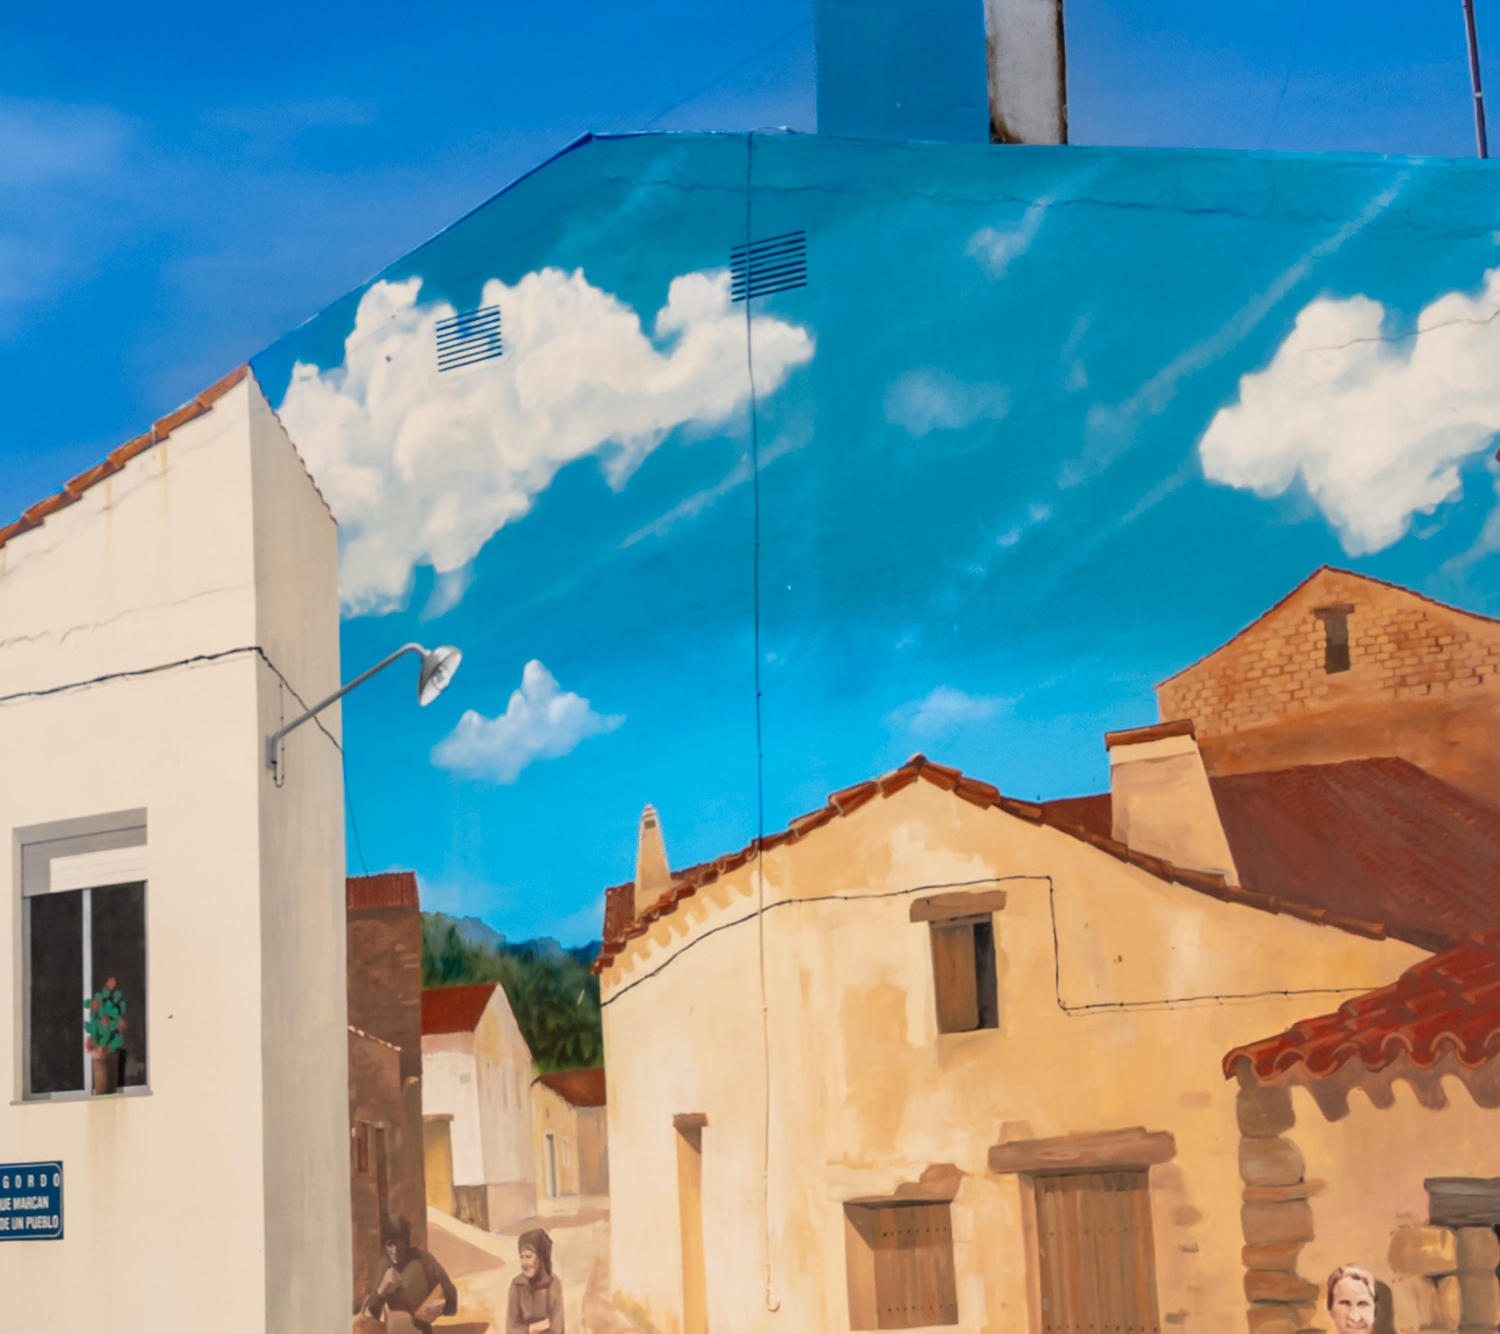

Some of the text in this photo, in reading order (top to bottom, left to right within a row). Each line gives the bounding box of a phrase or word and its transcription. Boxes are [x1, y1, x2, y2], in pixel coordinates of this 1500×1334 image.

[13, 1196, 49, 1210] MARCAN
[0, 1217, 10, 1231] DE
[12, 1216, 24, 1230] UN
[26, 1215, 59, 1229] PUEBLO
